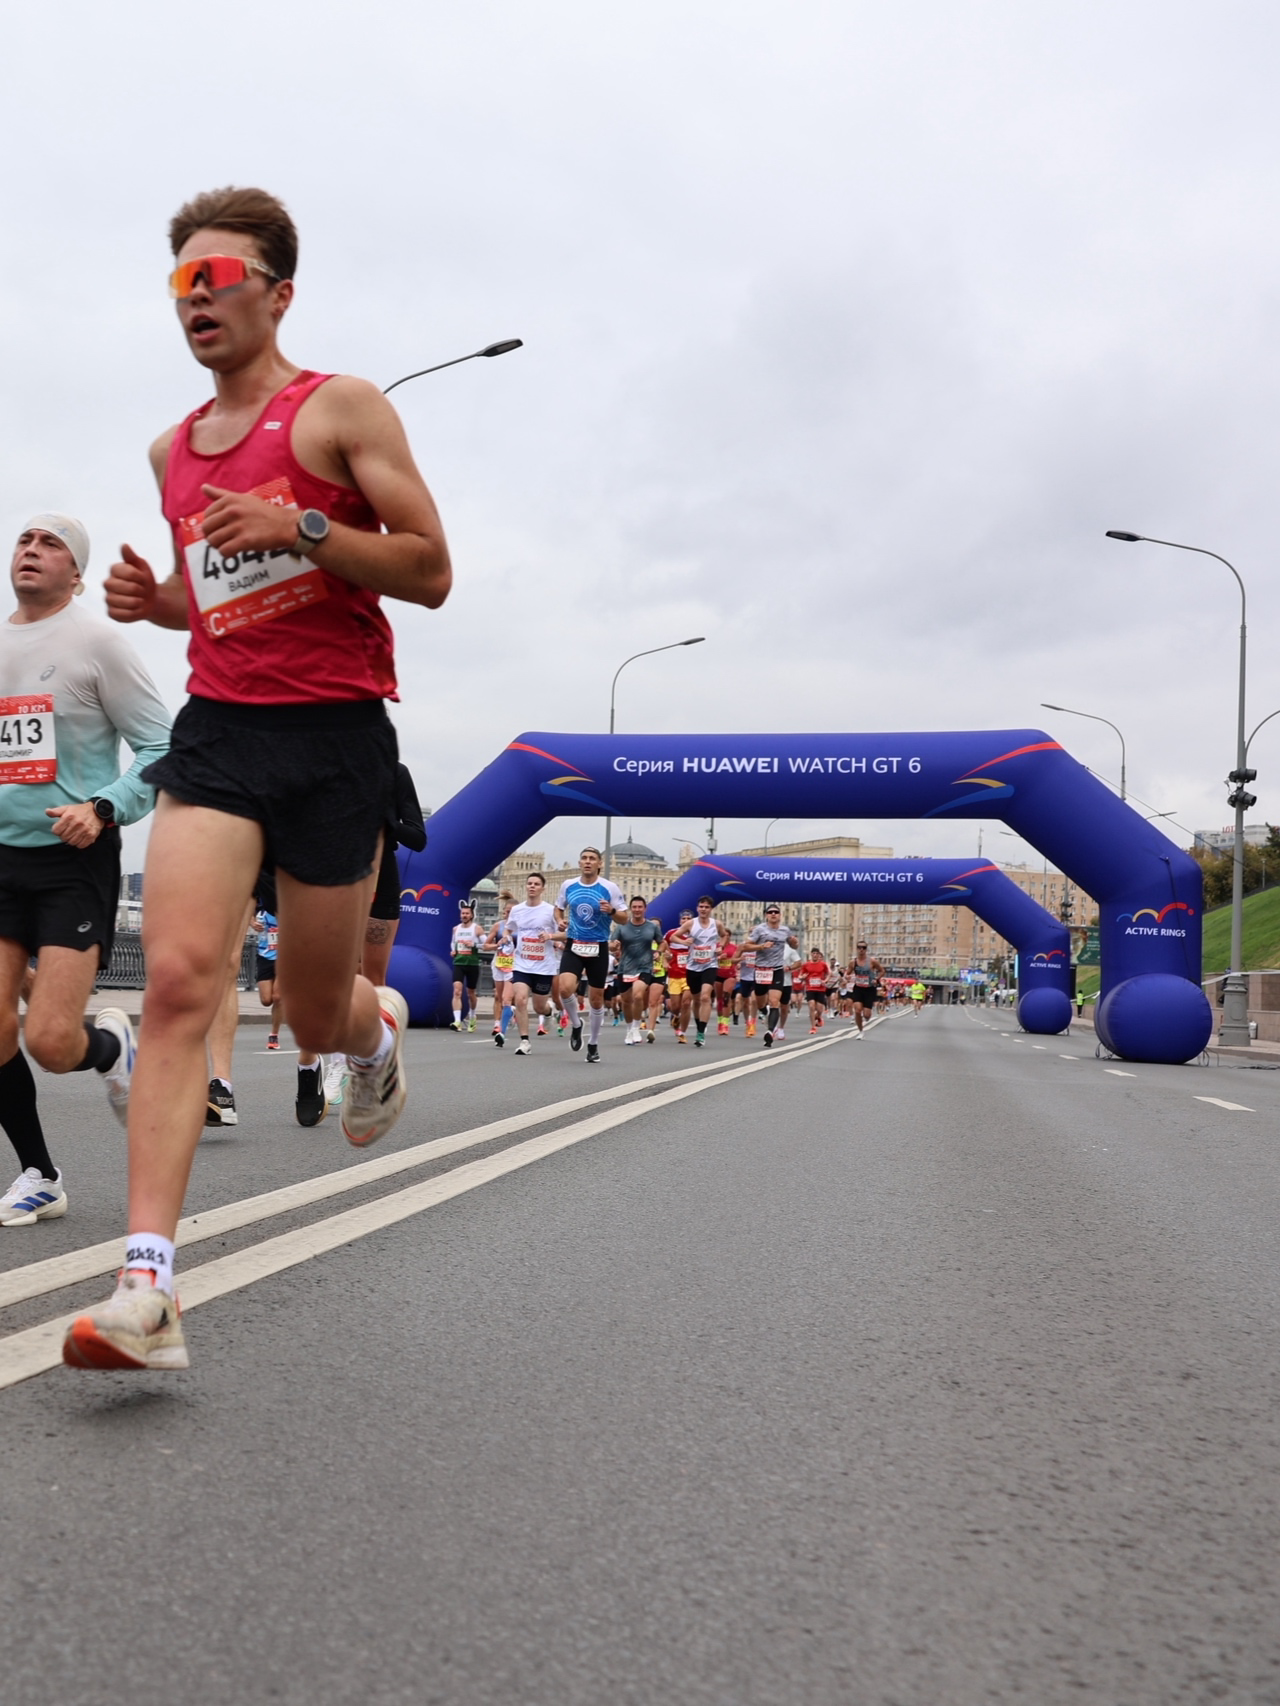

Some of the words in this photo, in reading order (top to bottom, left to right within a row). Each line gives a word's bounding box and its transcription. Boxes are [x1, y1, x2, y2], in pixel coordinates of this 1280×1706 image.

[228, 569, 271, 593] ВАДИМ
[17, 705, 29, 714] 10
[613, 757, 674, 776] Серия
[683, 757, 779, 773] HUAWEI
[788, 757, 867, 773] WATCH
[872, 757, 902, 774] GT
[908, 757, 921, 773] 6
[755, 870, 790, 882] Серия
[794, 871, 847, 881] HUAWEI
[851, 872, 895, 882] WATCH
[896, 873, 913, 882] GT
[915, 873, 924, 882] 6
[417, 906, 440, 916] RINGS
[1125, 927, 1158, 936] ACTIVE
[1160, 928, 1186, 938] RINGS
[522, 944, 545, 954] 28088
[572, 944, 598, 954] 22777
